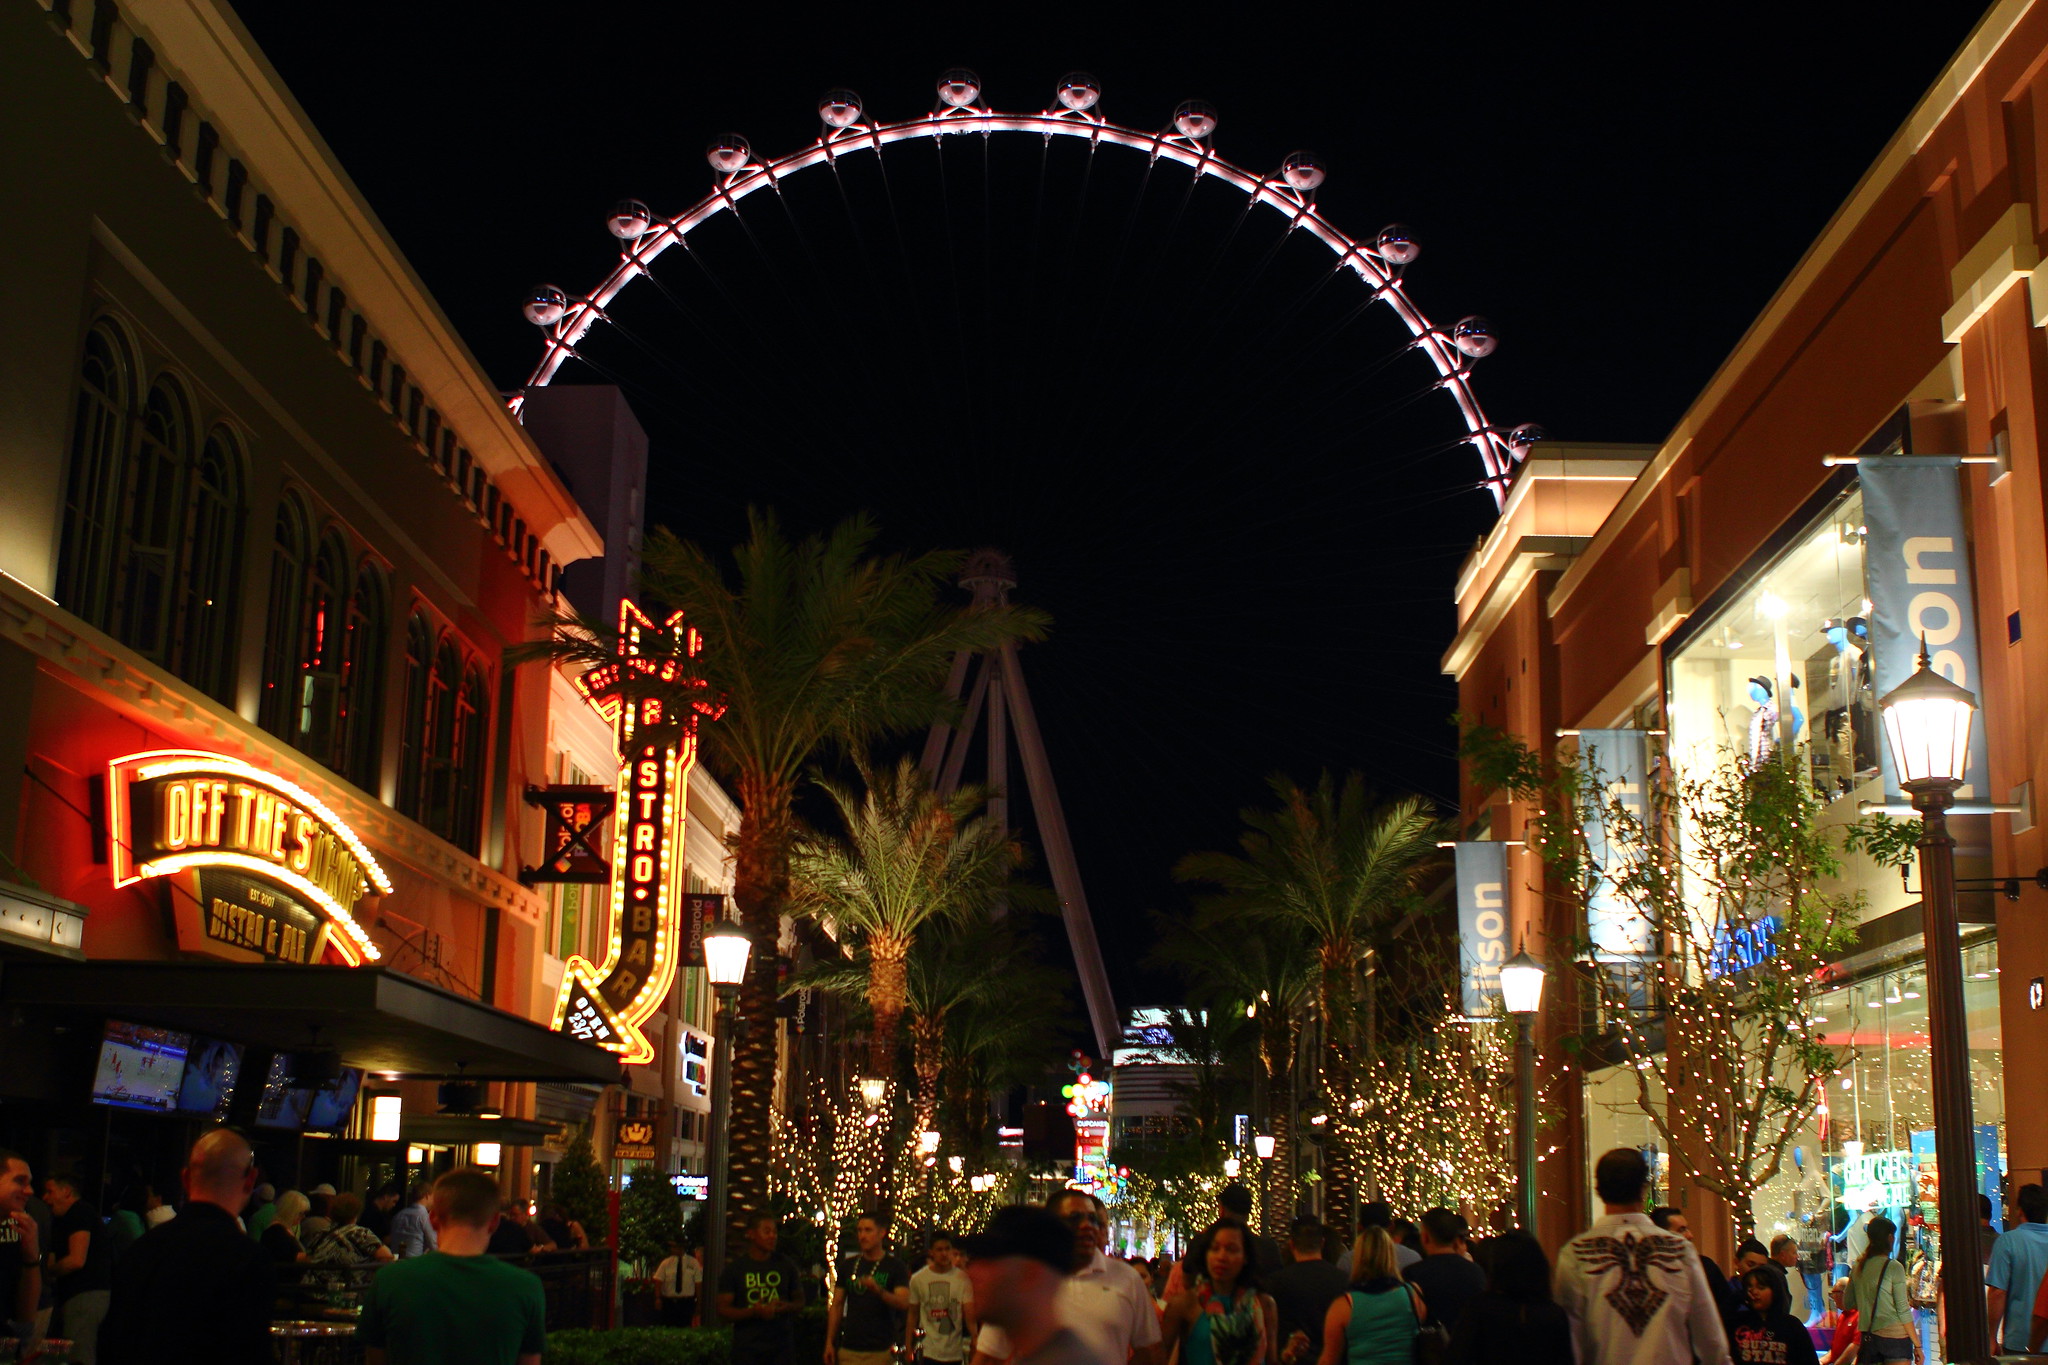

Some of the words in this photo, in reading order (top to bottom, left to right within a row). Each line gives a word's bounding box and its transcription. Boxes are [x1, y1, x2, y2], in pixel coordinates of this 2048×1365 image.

[166, 779, 228, 850] OFF
[235, 781, 291, 862] THE
[690, 899, 702, 949] Polaroid
[610, 905, 652, 999] BAR
[568, 1012, 594, 1040] 23/7
[575, 996, 611, 1040] OPEN
[745, 1270, 782, 1288] BLO
[1741, 1340, 1788, 1352] SUPER
[1741, 1349, 1787, 1365] STAR
